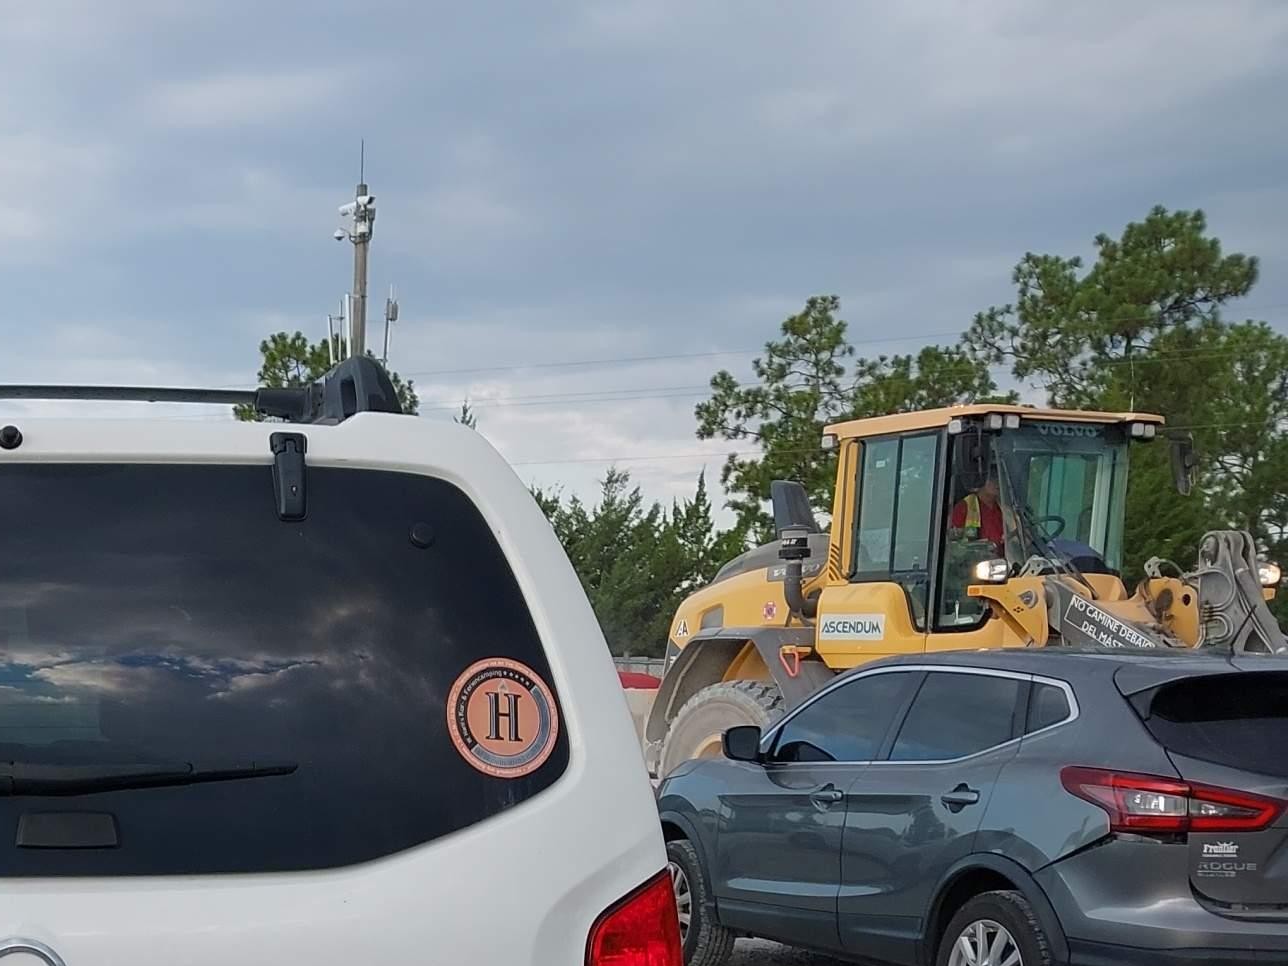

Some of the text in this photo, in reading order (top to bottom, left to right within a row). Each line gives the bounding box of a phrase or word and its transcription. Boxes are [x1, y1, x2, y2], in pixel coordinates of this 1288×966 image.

[1037, 424, 1097, 437] VOLVO
[1072, 597, 1086, 611] NO
[1086, 605, 1120, 633] CAMINE
[821, 621, 882, 633] ASCENDUM
[1081, 620, 1097, 639] DEL
[485, 692, 523, 742] H
[1197, 862, 1257, 870] ROGUE
